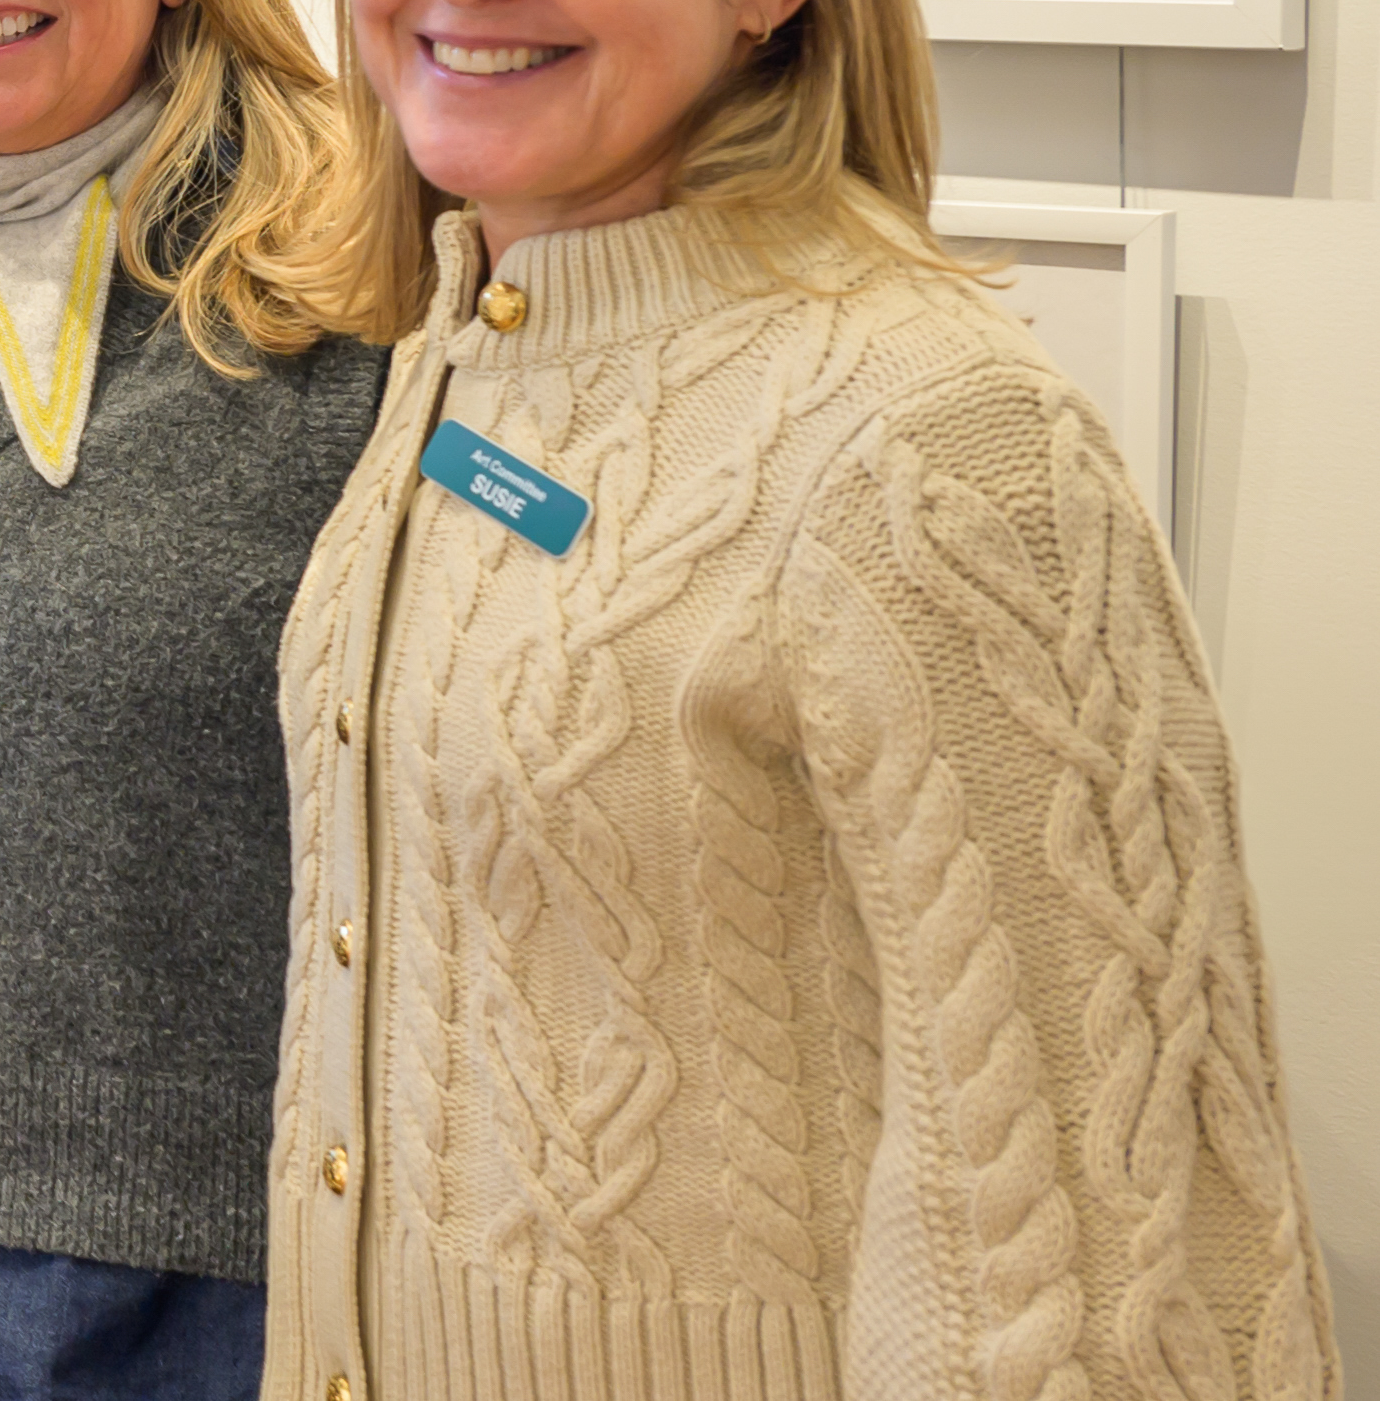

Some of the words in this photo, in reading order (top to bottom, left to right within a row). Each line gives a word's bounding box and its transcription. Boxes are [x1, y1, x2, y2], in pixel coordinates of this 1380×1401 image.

[469, 449, 491, 469] Art
[488, 459, 548, 503] Committee
[469, 473, 528, 520] SUSIE
